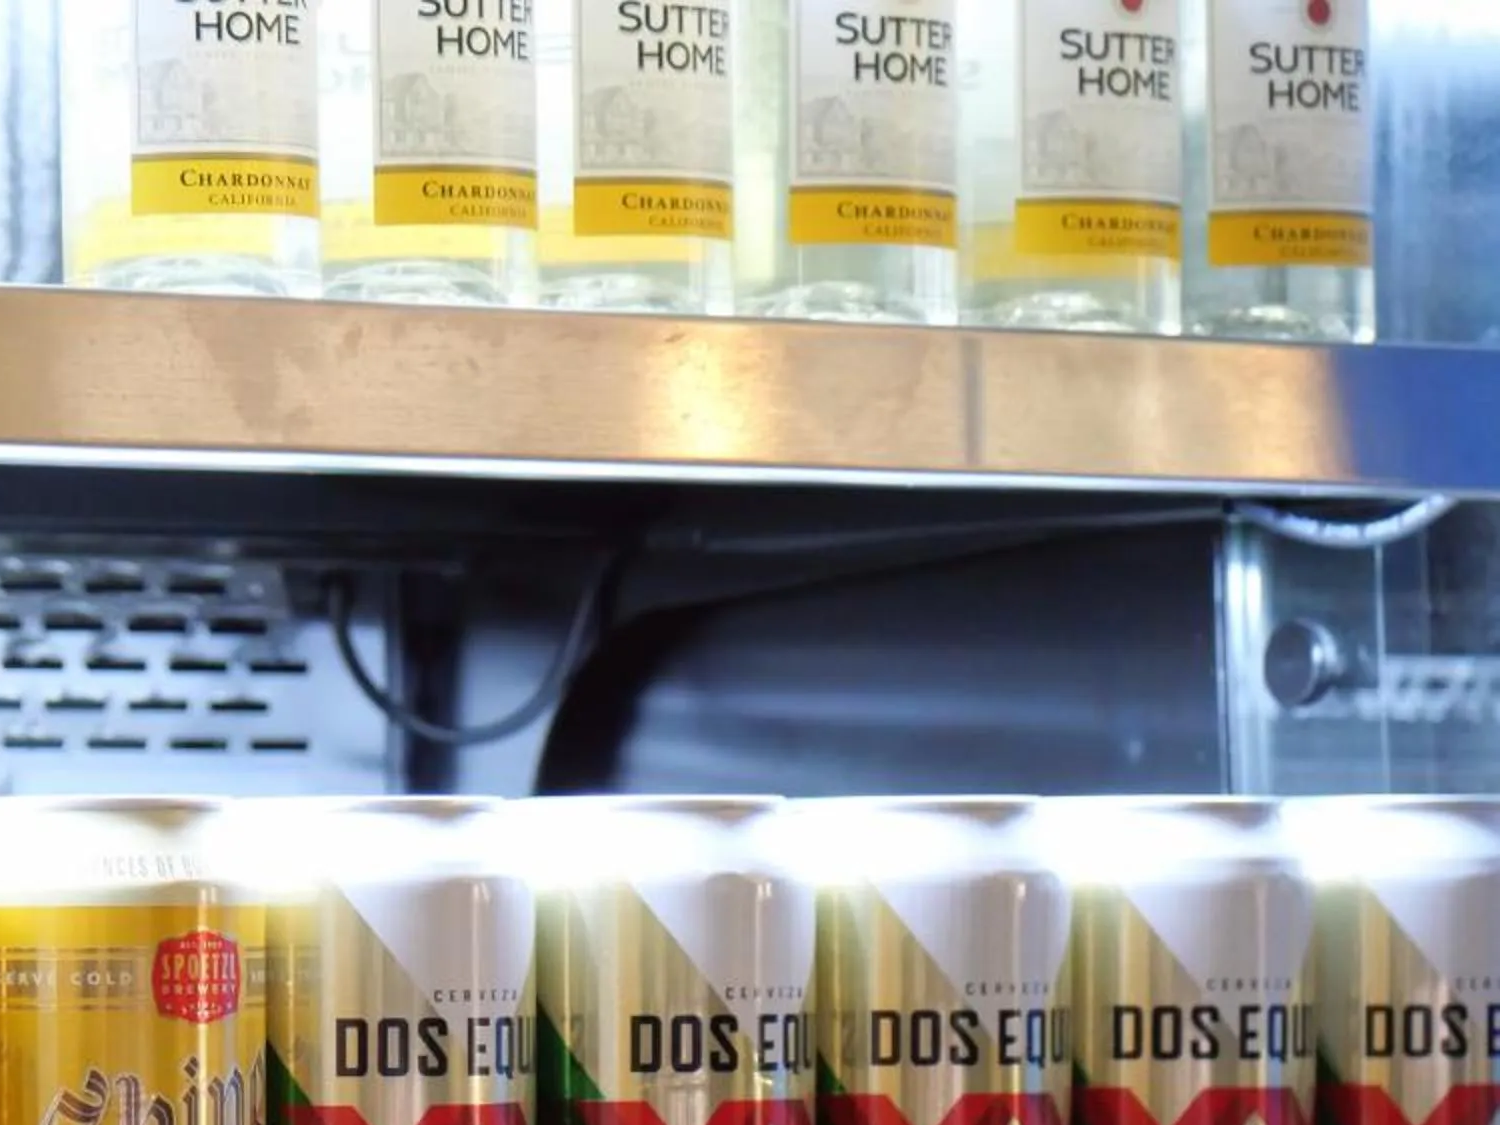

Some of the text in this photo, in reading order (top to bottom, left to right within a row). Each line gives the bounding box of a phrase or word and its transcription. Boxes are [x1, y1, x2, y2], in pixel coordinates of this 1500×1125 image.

[194, 11, 300, 45] HOME
[618, 1, 729, 39] SUTTER
[835, 12, 952, 49] SUTTER
[436, 25, 529, 61] HOME
[637, 40, 727, 76] HOME
[1060, 28, 1175, 65] SUTTER
[1249, 42, 1365, 76] SUTTER
[854, 51, 948, 87] HOME
[1077, 67, 1172, 102] HOME
[1268, 79, 1361, 112] HOME
[70, 972, 133, 986] COLD
[161, 953, 237, 980] SPOETZL
[335, 1015, 536, 1079] DOS EQU
[630, 1014, 739, 1073] DOS
[871, 1008, 1067, 1070] DOS EQU
[1112, 1004, 1310, 1063] DOS EQU
[1365, 1003, 1469, 1058] DOS
